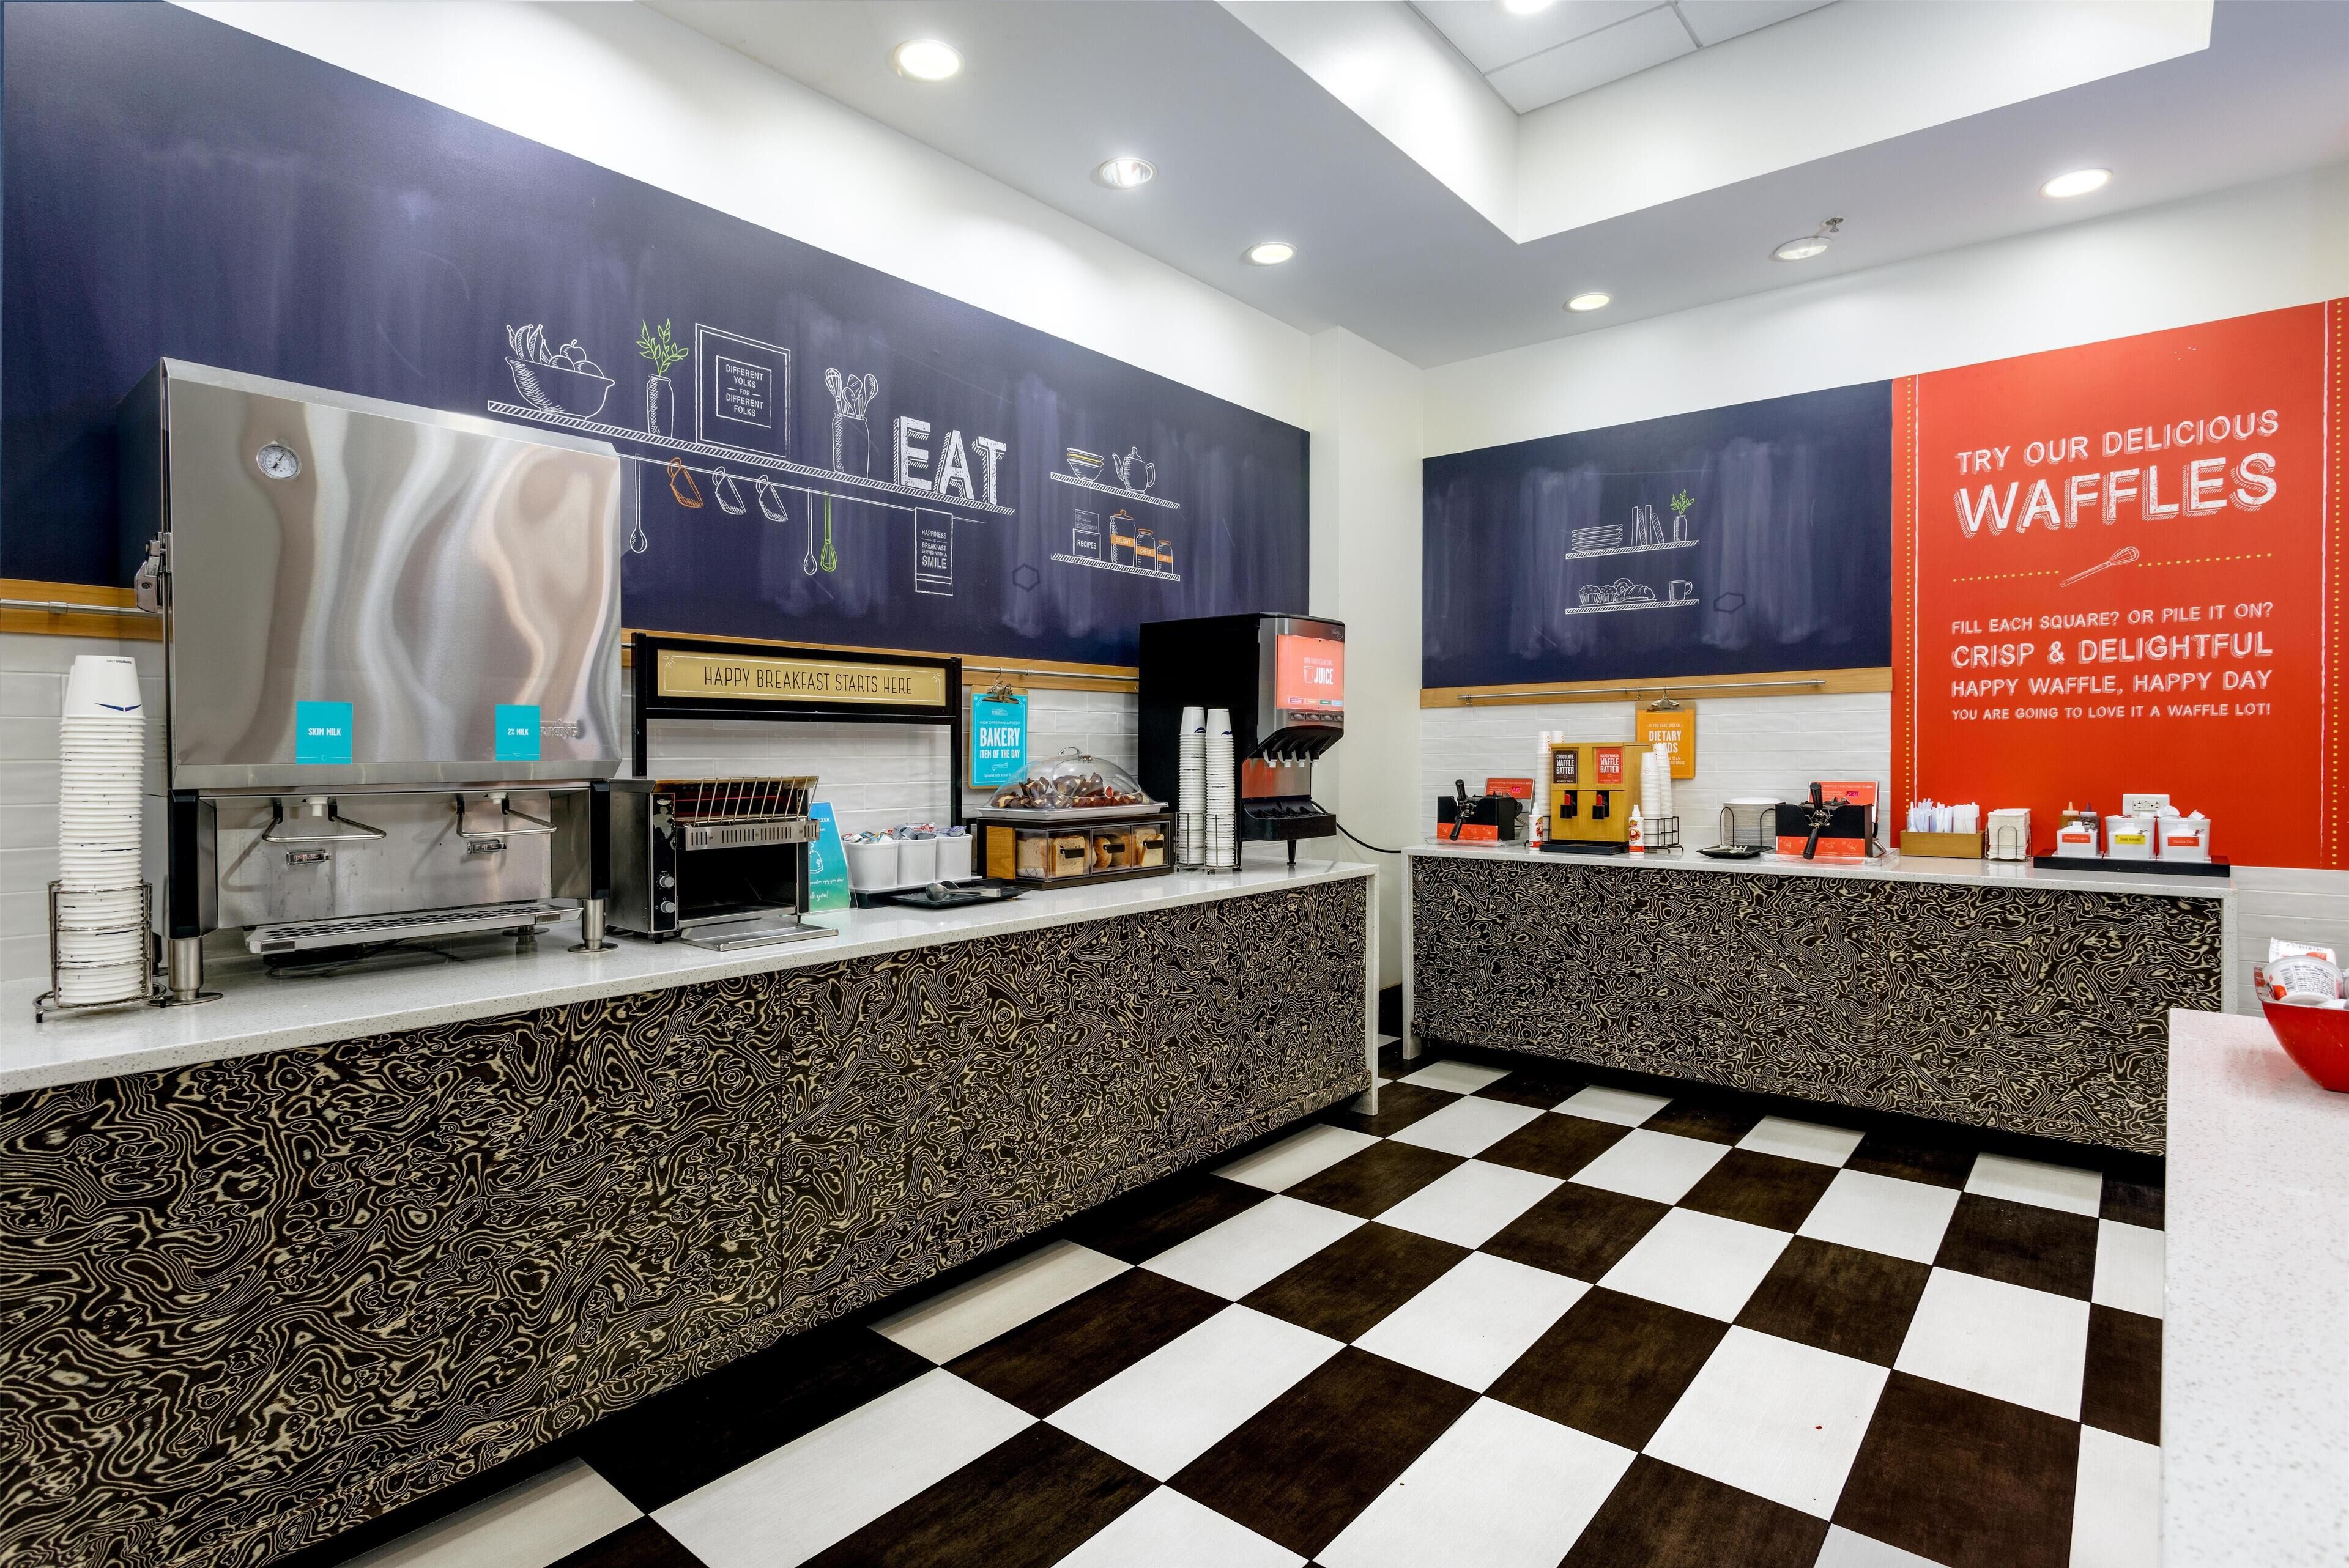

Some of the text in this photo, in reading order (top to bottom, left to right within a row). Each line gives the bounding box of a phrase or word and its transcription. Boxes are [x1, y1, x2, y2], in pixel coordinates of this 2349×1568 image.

[726, 364, 763, 381] DIFFERENT
[733, 375, 756, 388] YOLKS
[726, 393, 763, 409] DIFFERENT
[734, 405, 756, 416] FOLKS
[1955, 409, 2279, 475] TRY OUR DELICIOUS
[893, 415, 1008, 505] EAT
[1953, 452, 2279, 539] WAFFLES
[921, 529, 947, 539] HAPPINESS
[922, 542, 946, 552] BREAKFAST
[1077, 539, 1097, 550] RECIPES
[922, 555, 947, 569] SMILE
[1952, 602, 2274, 635] FILL EACH SQUARE? OR PILE IT ON?
[1951, 632, 2273, 668] CRISP & DELIGHTFUL
[705, 666, 912, 695] HAPPY BREAKFAST STARTS HERE
[1314, 667, 1334, 685] JUICE
[1951, 670, 2273, 698] HAPPY WAFFLE, HAPPY DAY
[1951, 703, 2271, 721] YOU ARE GOING TO LOVE IT A WAFFLE LOT!
[308, 727, 341, 736] SKIM MILK
[548, 726, 577, 738] KING
[979, 727, 1020, 747] BAKERY
[1649, 731, 1682, 741] DIETARY
[979, 750, 1020, 759] ITEM OF THE DAY
